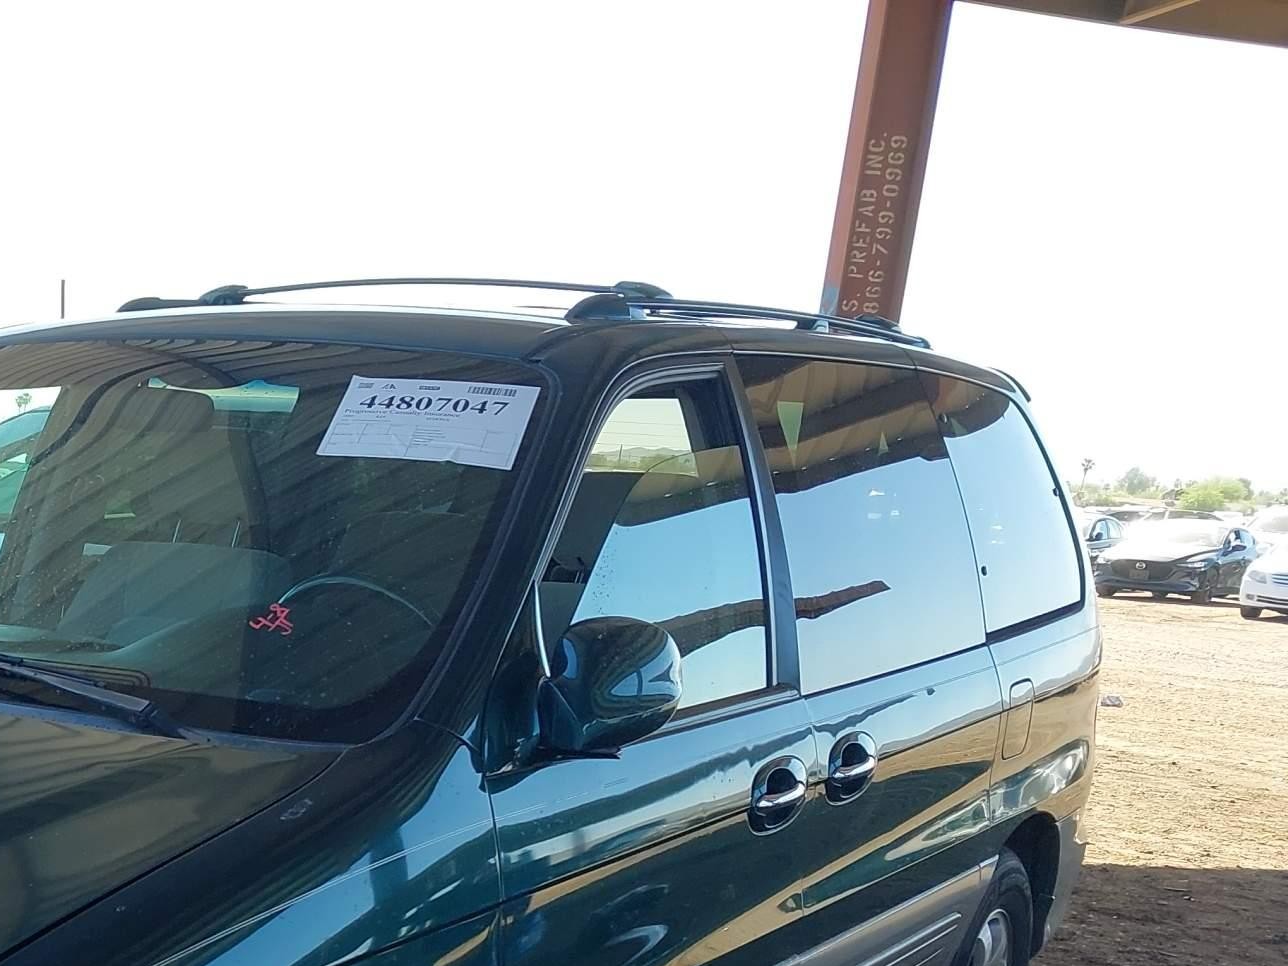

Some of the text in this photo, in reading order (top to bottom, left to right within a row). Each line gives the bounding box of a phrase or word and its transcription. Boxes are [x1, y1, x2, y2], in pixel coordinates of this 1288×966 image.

[848, 189, 878, 278] PREFAB
[864, 132, 888, 176] INC.
[359, 394, 509, 416] 44807047
